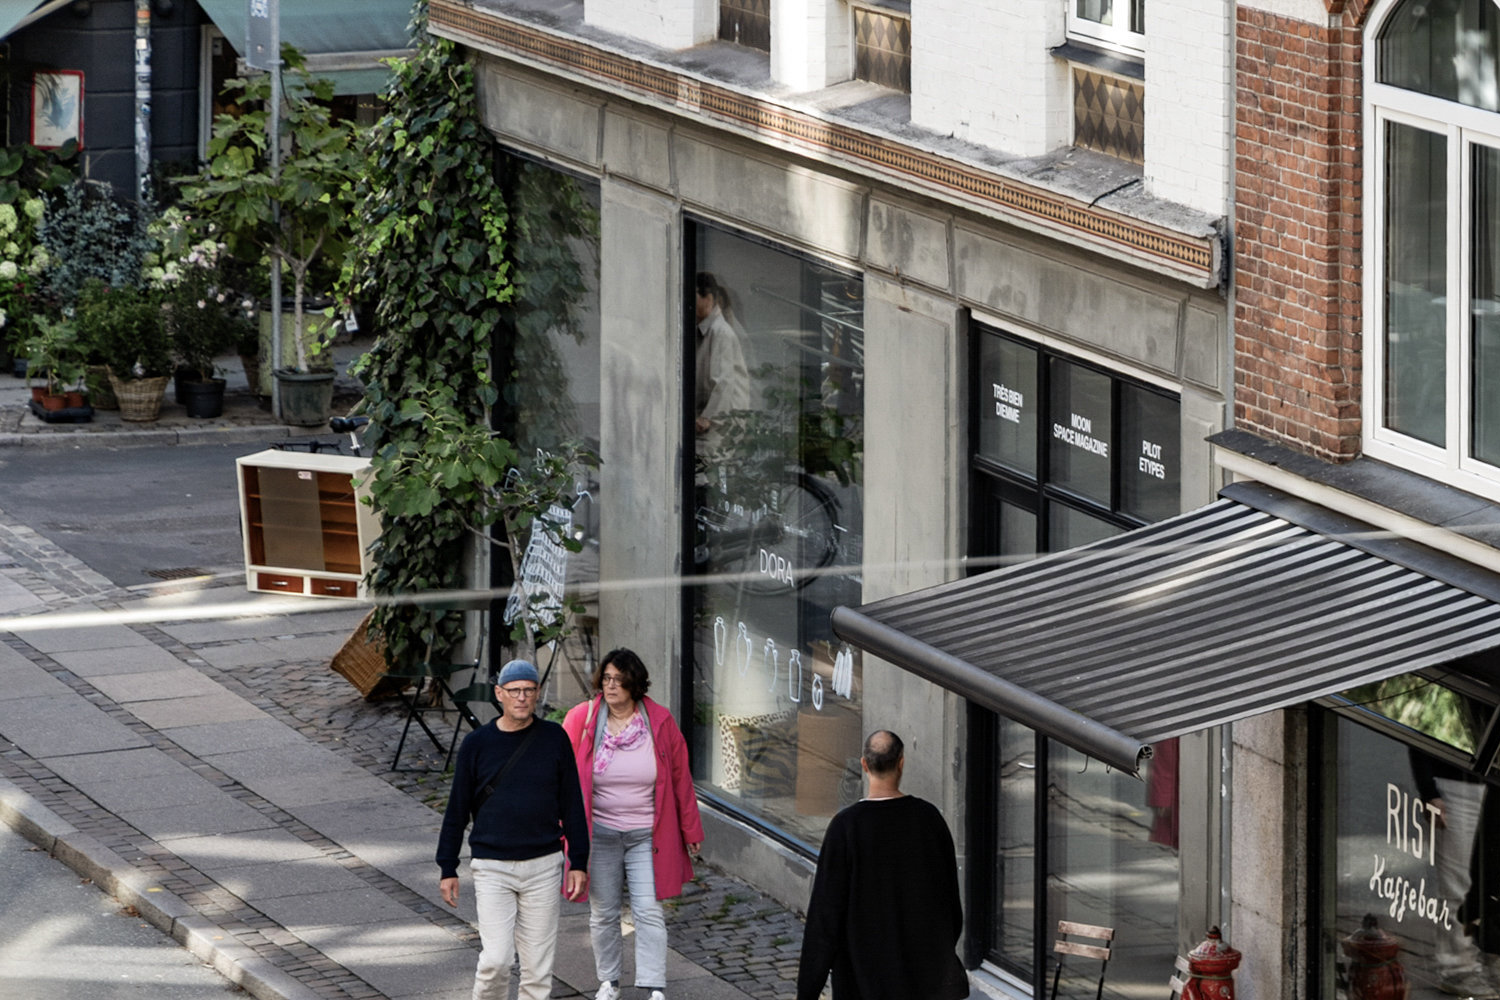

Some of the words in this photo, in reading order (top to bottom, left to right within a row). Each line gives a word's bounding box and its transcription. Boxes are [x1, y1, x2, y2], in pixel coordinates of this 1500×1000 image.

[1009, 389, 1023, 408] BIEN
[1071, 413, 1091, 433] MOON
[1053, 423, 1074, 445] SPACE
[1074, 430, 1109, 458] MAGAZINE
[1142, 440, 1161, 460] PILOT
[1139, 457, 1165, 480] ETYPES
[760, 548, 794, 587] DORA
[1386, 783, 1441, 866] RIST
[1369, 854, 1452, 931] Kaffebar
